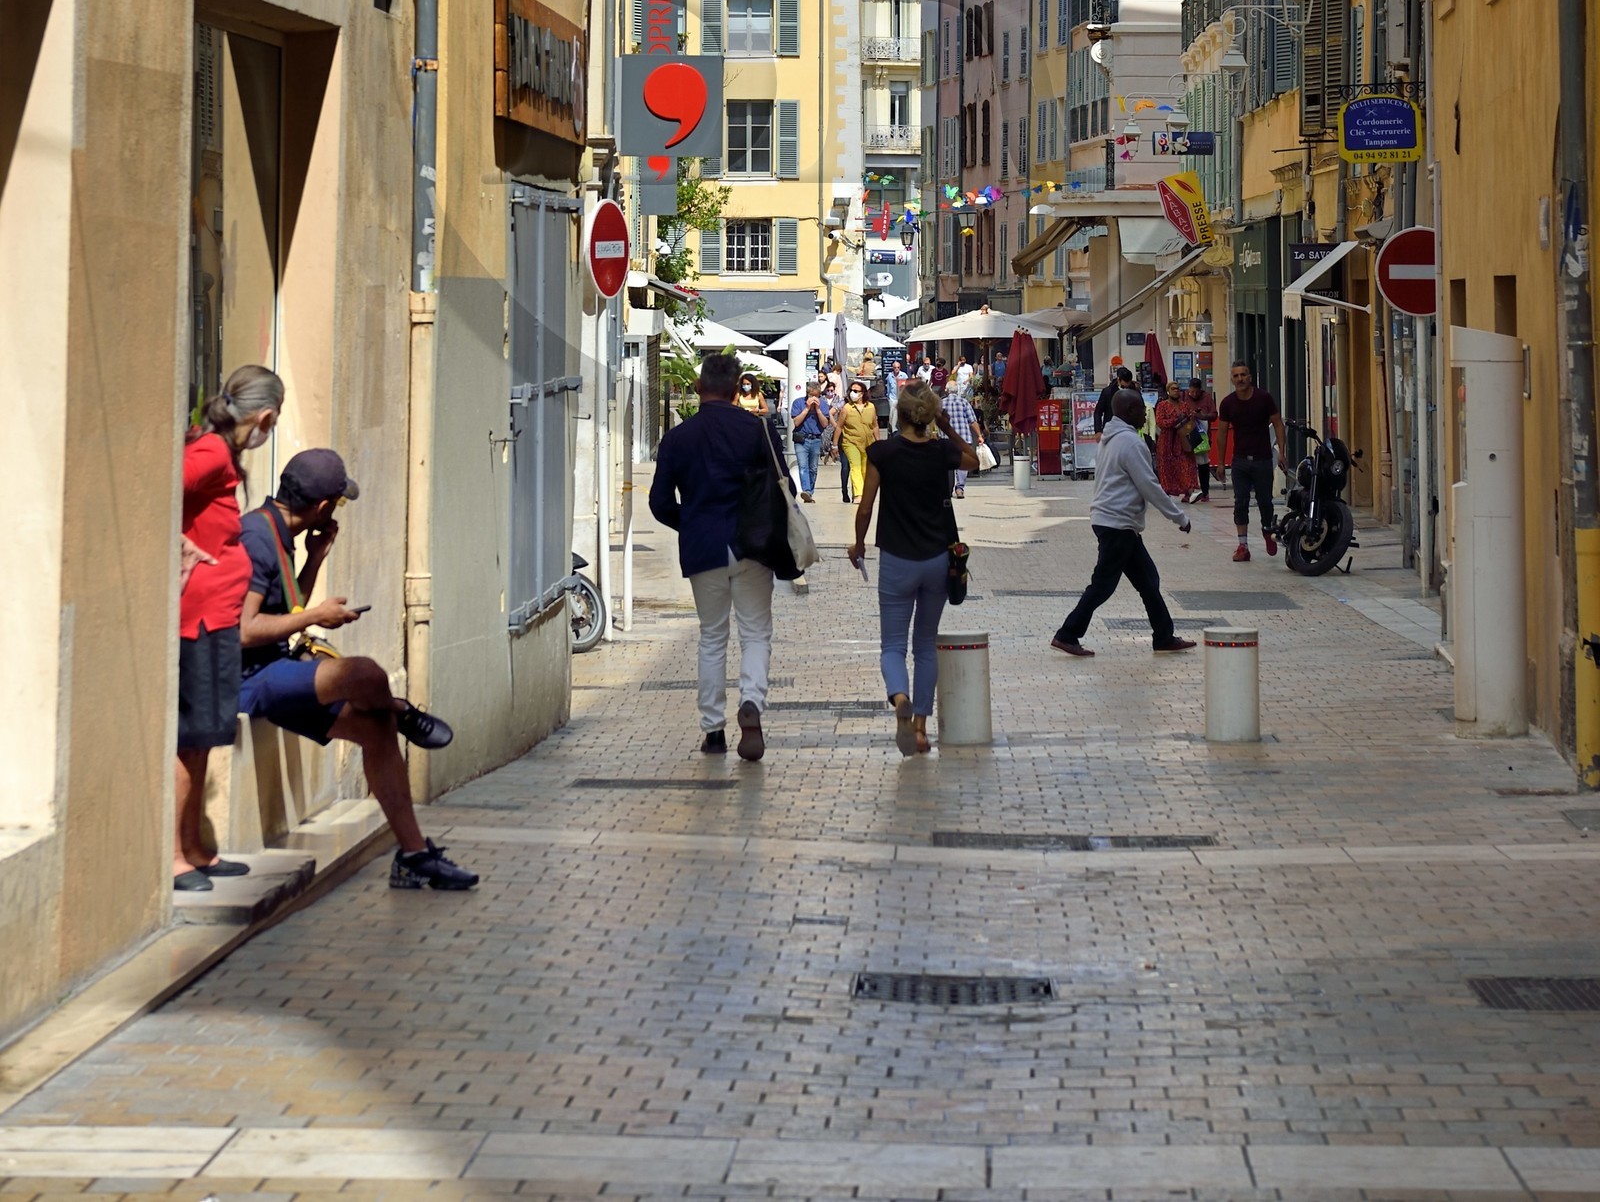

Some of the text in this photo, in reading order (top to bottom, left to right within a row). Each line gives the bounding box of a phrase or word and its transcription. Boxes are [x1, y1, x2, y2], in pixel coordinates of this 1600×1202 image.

[1349, 99, 1370, 111] MULTI
[1371, 98, 1403, 107] SERVICES
[1356, 118, 1404, 126] Cordonnerie
[1349, 128, 1366, 137] Clés
[1372, 127, 1412, 136] Serrurerie
[1364, 138, 1398, 147] Tampons
[1353, 152, 1364, 160] 04
[1378, 151, 1388, 159] 92
[1389, 151, 1399, 159] 81
[1402, 150, 1411, 158] 21
[1164, 192, 1192, 233] TABAC
[1192, 200, 1211, 241] PRESSE
[1293, 251, 1305, 260] Le
